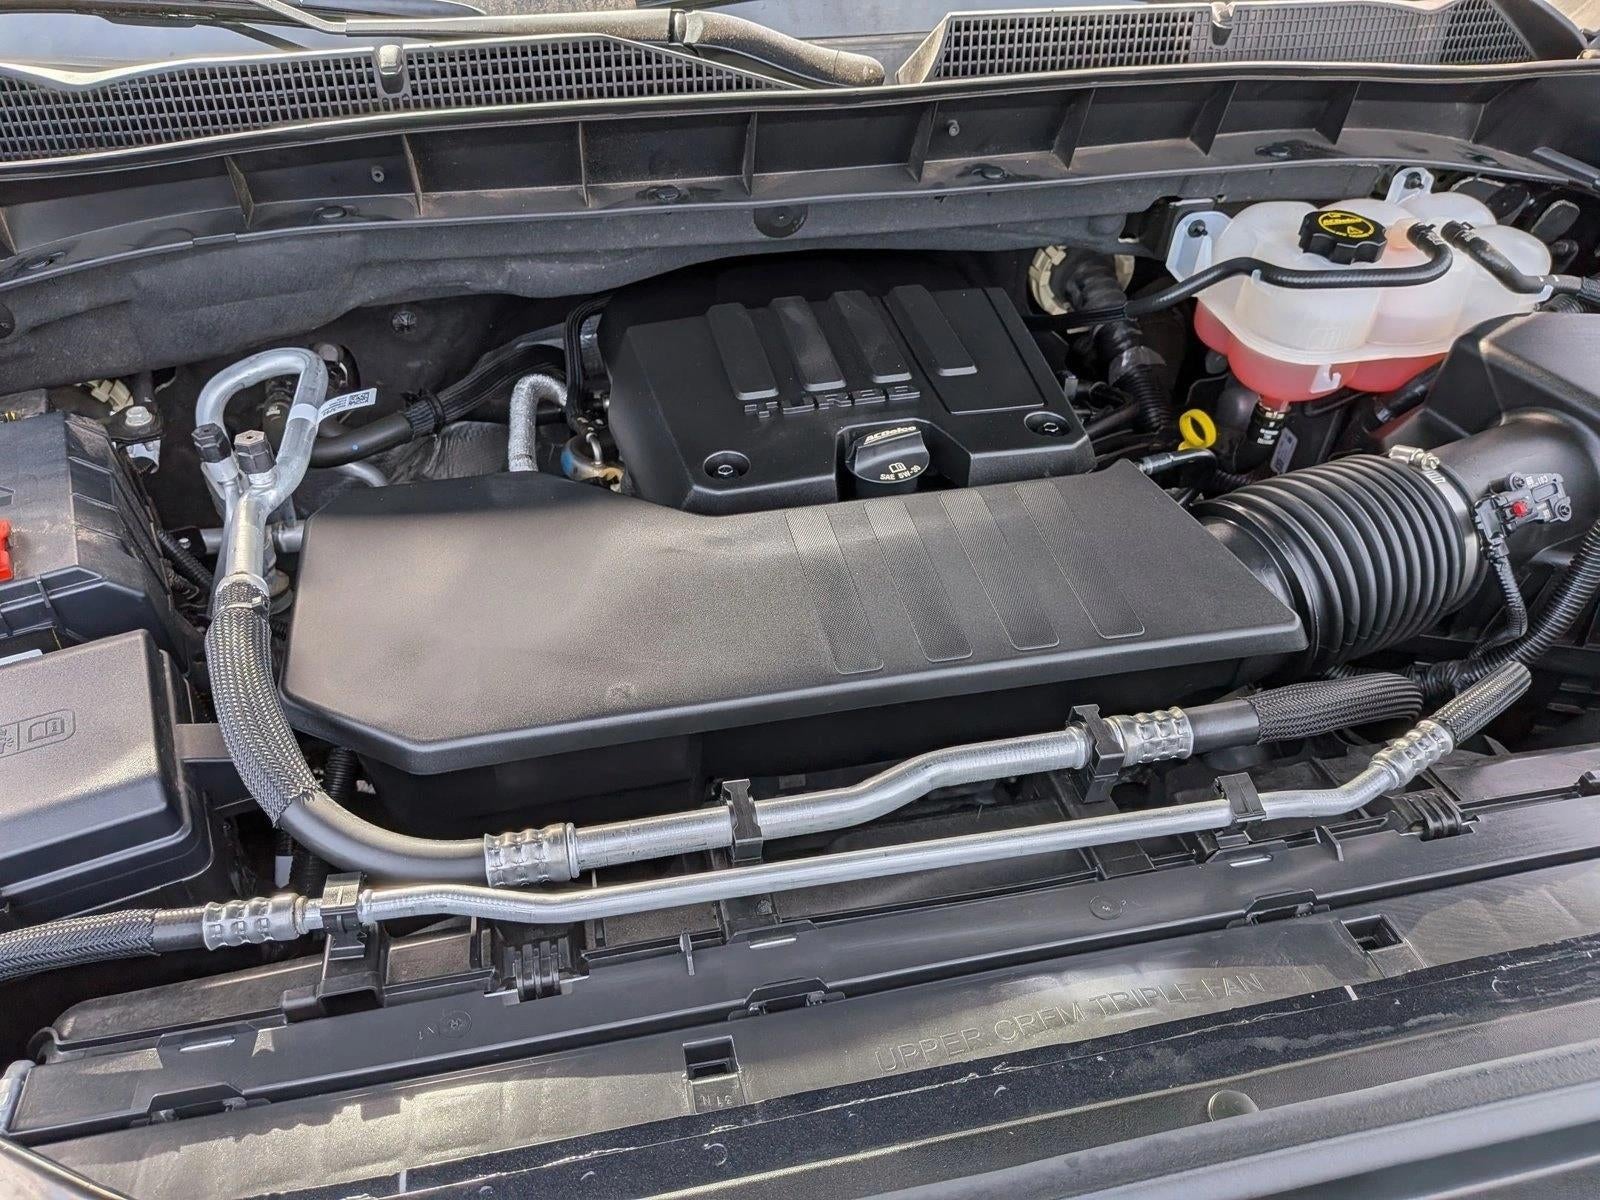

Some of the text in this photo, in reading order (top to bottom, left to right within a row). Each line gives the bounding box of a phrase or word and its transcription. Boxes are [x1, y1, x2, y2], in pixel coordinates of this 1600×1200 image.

[744, 383, 920, 418] TURBO
[864, 426, 917, 445] ACDelco
[880, 473, 896, 481] SAE
[874, 1027, 990, 1072] UPPER
[1088, 983, 1200, 1017] TRIPLE
